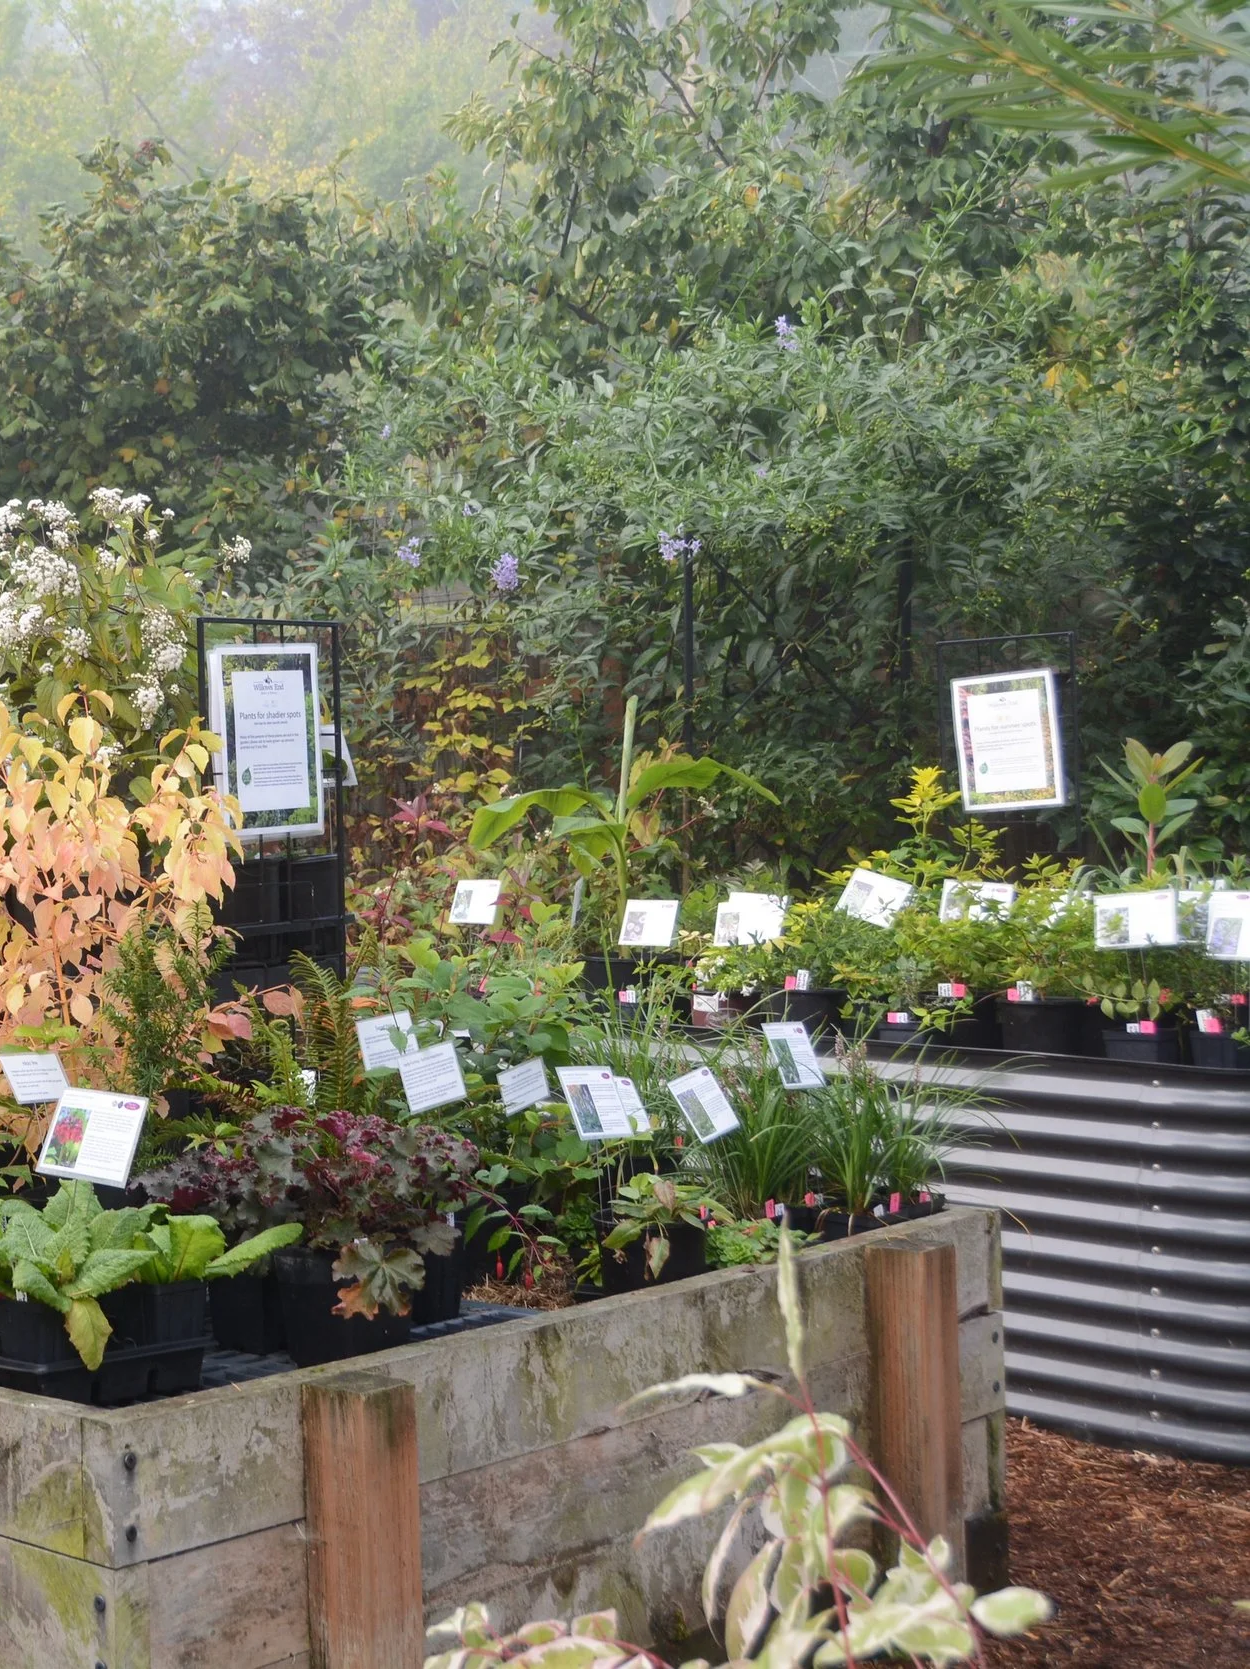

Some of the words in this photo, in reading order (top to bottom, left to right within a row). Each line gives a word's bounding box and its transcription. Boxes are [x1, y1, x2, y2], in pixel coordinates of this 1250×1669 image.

[239, 712, 256, 720] Plants
[257, 711, 265, 719] for
[266, 711, 285, 719] shadier
[286, 711, 302, 719] spots
